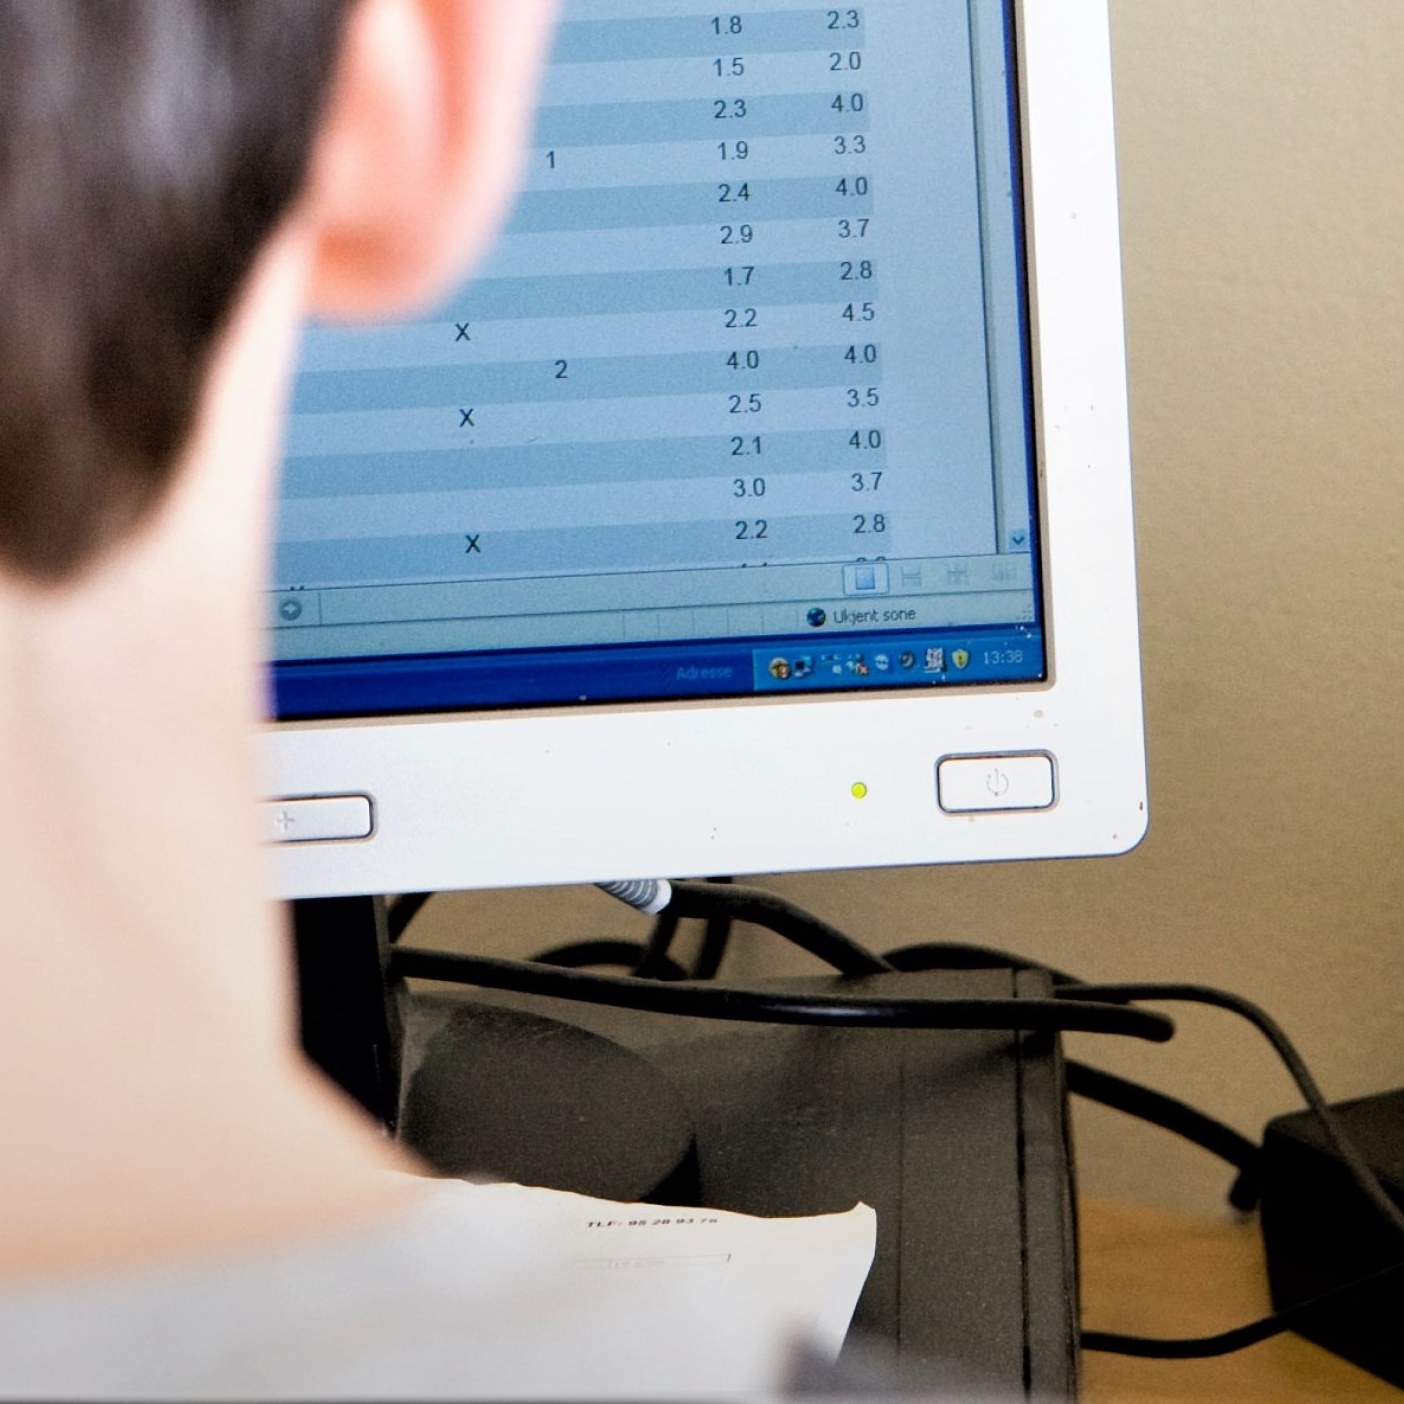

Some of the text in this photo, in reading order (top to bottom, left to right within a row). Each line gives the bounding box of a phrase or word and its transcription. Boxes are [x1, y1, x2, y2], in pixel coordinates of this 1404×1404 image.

[712, 10, 859, 34] 1.8 2.3
[714, 52, 861, 76] 1.5 2.0
[714, 93, 863, 119] 2.3 4.0
[547, 135, 866, 168] 1 1.9 3.3
[719, 177, 868, 202] 2.4 4.0
[720, 218, 869, 244] 2.9 3.7
[724, 261, 872, 286] 1.7 2.8
[456, 302, 874, 341] X 2.2 4.5
[555, 344, 876, 379] 2 4.0 4.0
[460, 387, 879, 427] X 2.5 3.5
[731, 430, 881, 455] 2.1 4.0
[734, 472, 882, 497] 3.0 3.7
[466, 514, 885, 553] X 2.2 2.8
[833, 606, 917, 626] Ukjent sone
